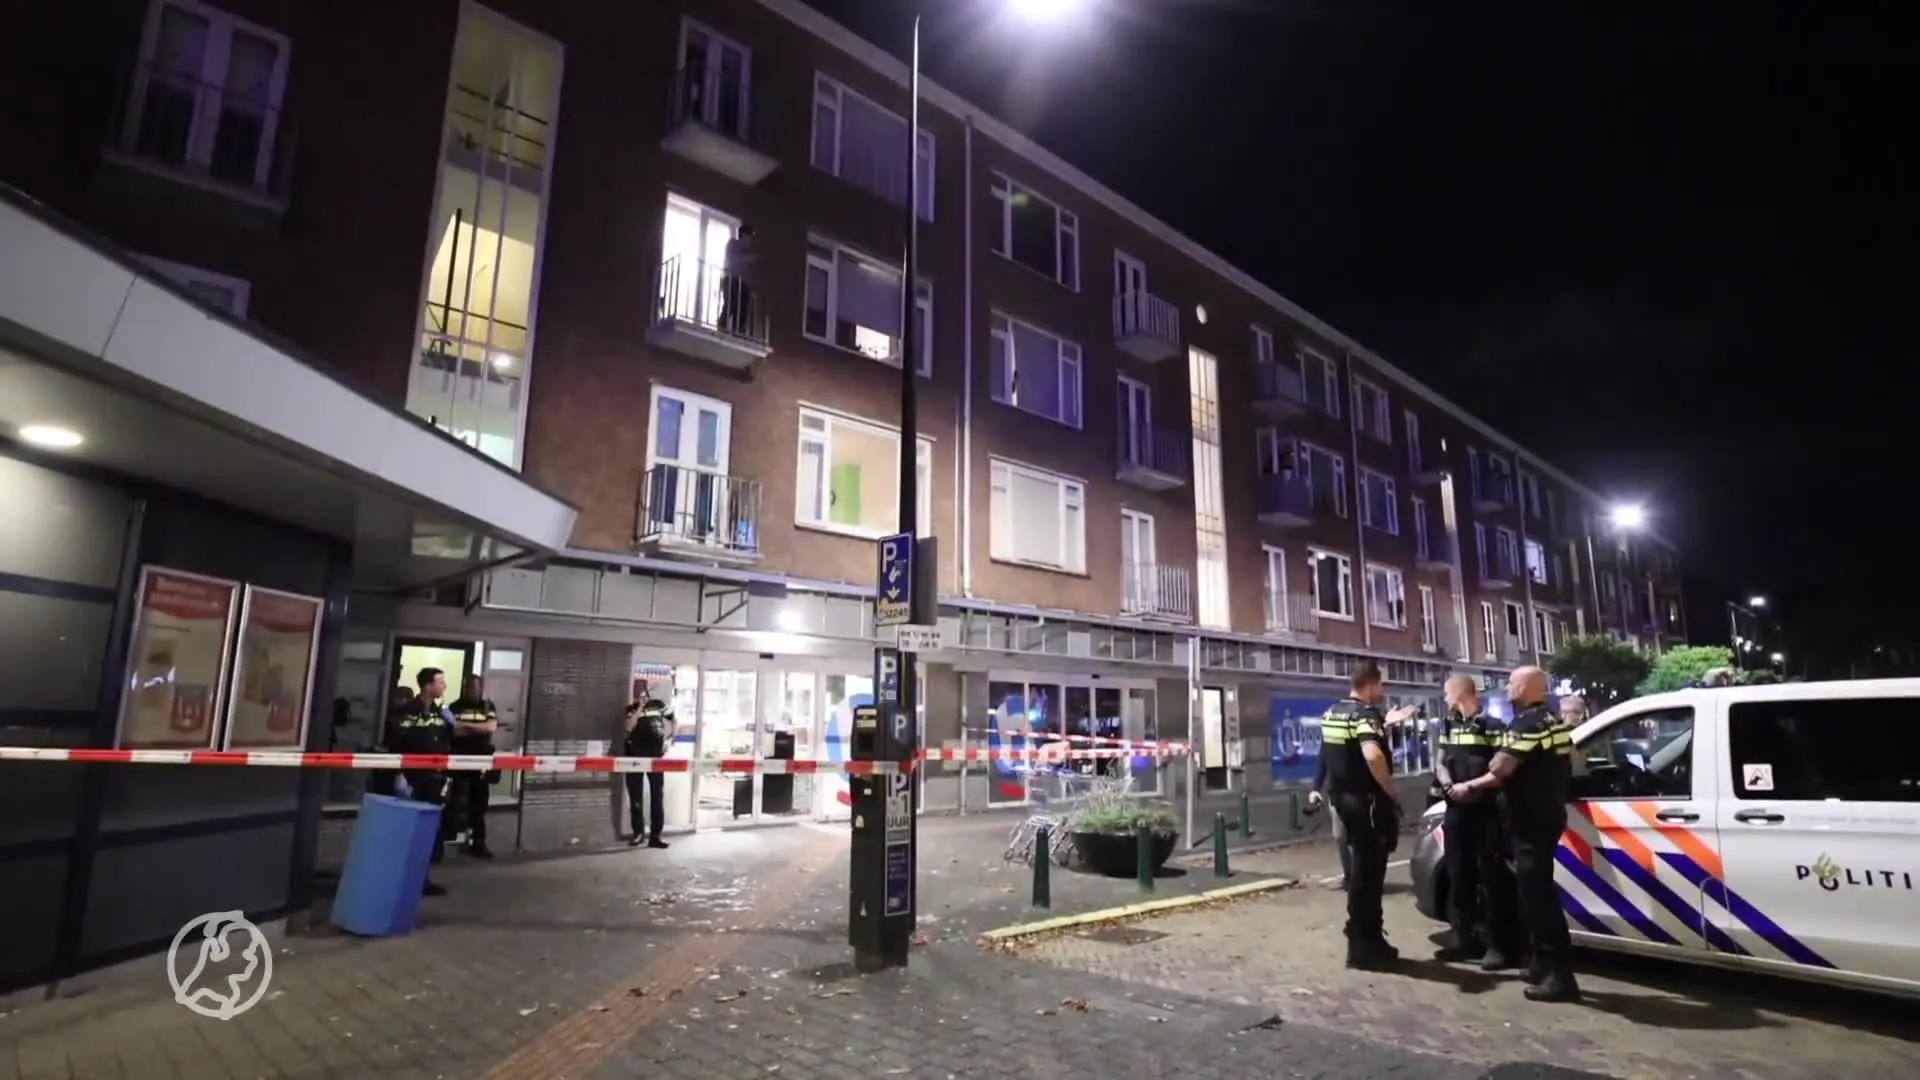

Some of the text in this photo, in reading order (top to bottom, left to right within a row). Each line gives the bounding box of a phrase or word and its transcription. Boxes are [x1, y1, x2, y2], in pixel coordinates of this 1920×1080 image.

[882, 541, 897, 574] P
[880, 655, 897, 683] P
[894, 713, 907, 740] P
[890, 770, 908, 800] P
[886, 815, 910, 829] UUR
